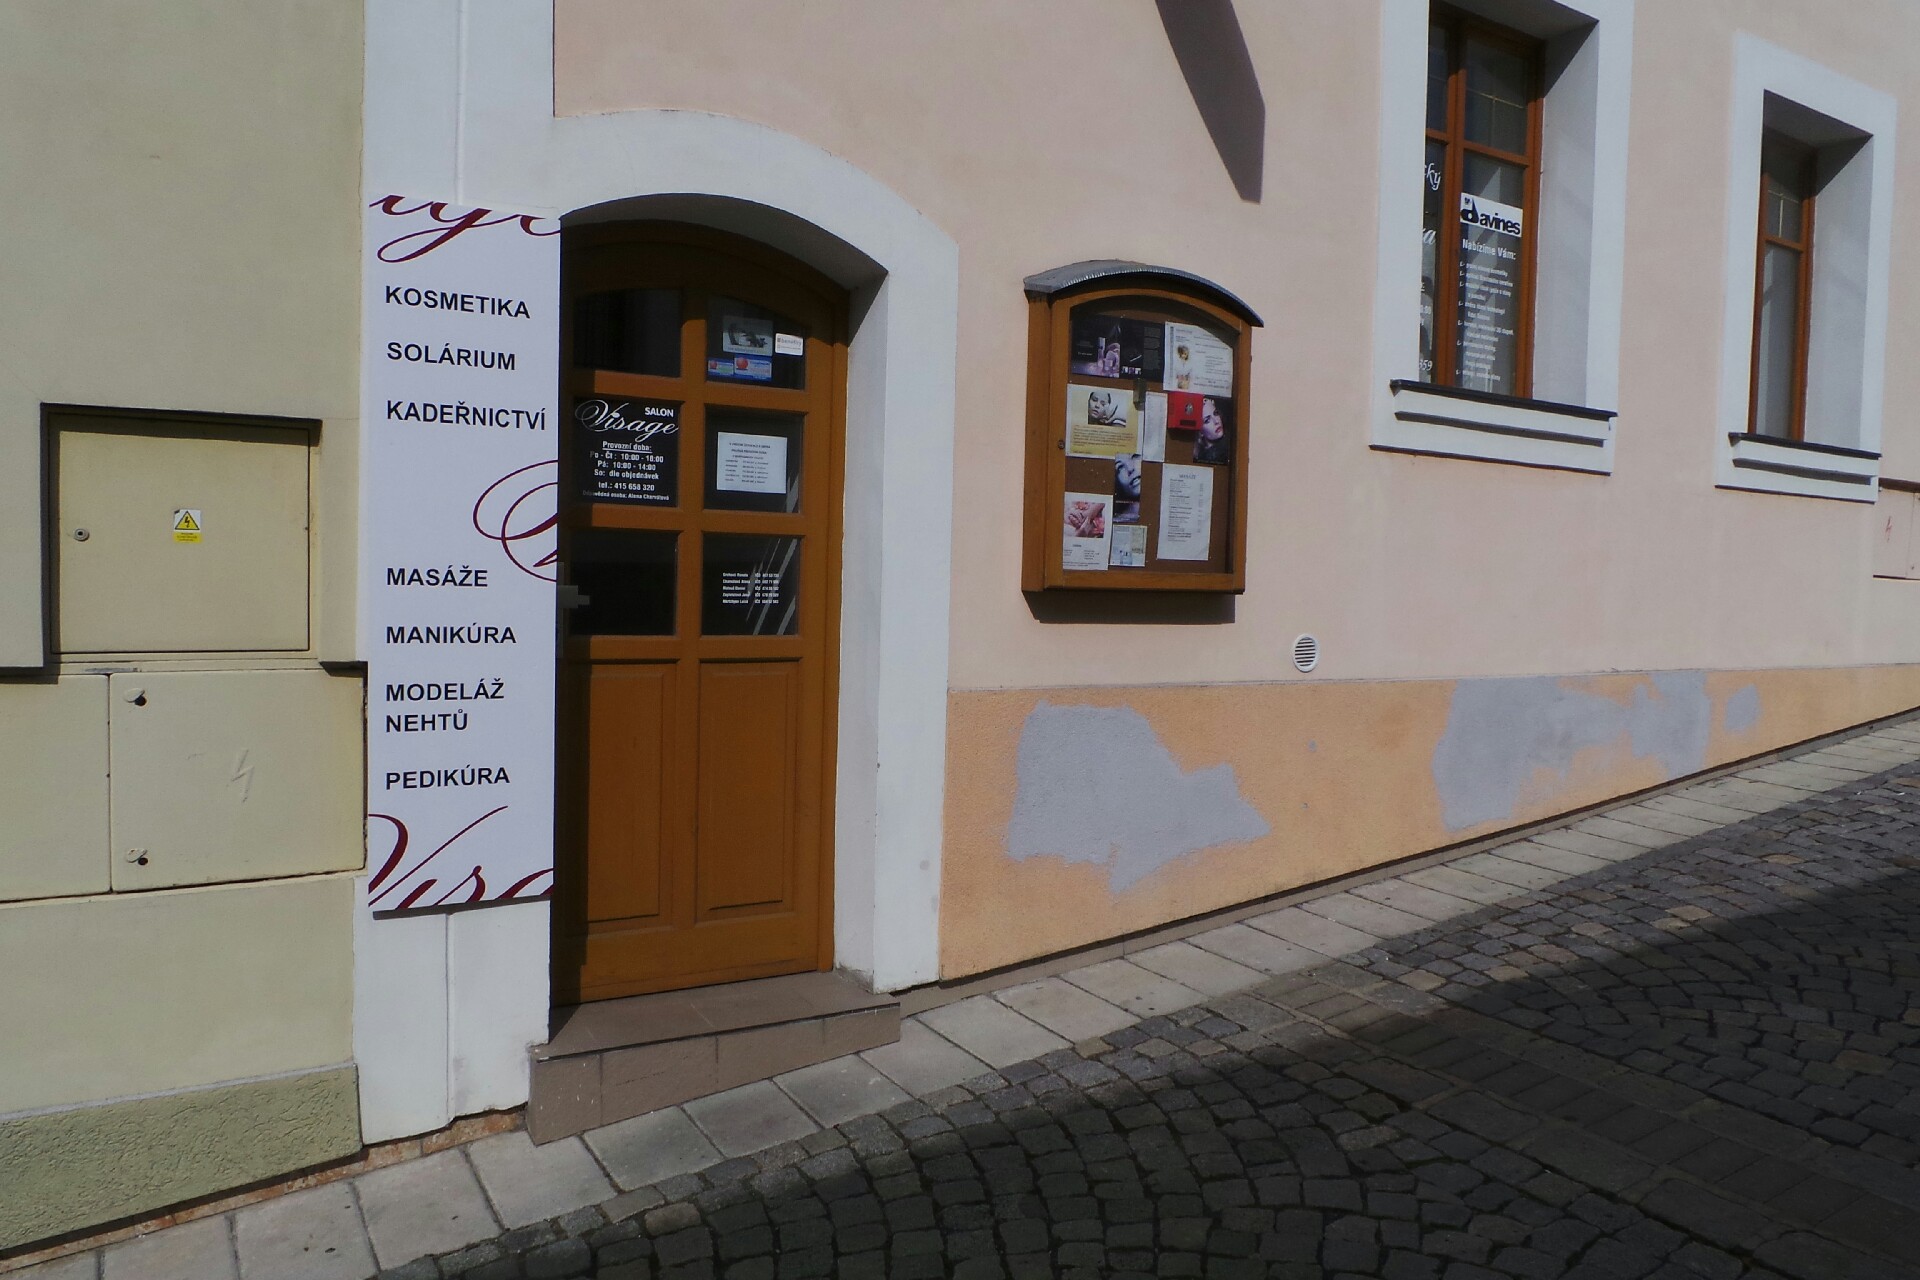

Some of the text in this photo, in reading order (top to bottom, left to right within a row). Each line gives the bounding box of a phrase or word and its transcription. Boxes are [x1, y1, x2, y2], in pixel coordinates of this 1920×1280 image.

[1460, 197, 1521, 236] davines
[385, 285, 530, 319] KOSMETIKA
[387, 342, 516, 371] SOLÁRIUM
[387, 400, 546, 431] KADEŘNICTVÍ
[575, 399, 679, 442] Visage
[645, 407, 674, 418] SALON
[602, 441, 653, 451] Provozní doba:
[614, 482, 626, 490] 415
[386, 565, 488, 587] MASÁŽE
[386, 622, 517, 644] MANIKÚRA
[386, 678, 505, 702] MODELÁŽ
[386, 709, 468, 732] NEHTŮ
[386, 765, 510, 790] PEDIKÚRA
